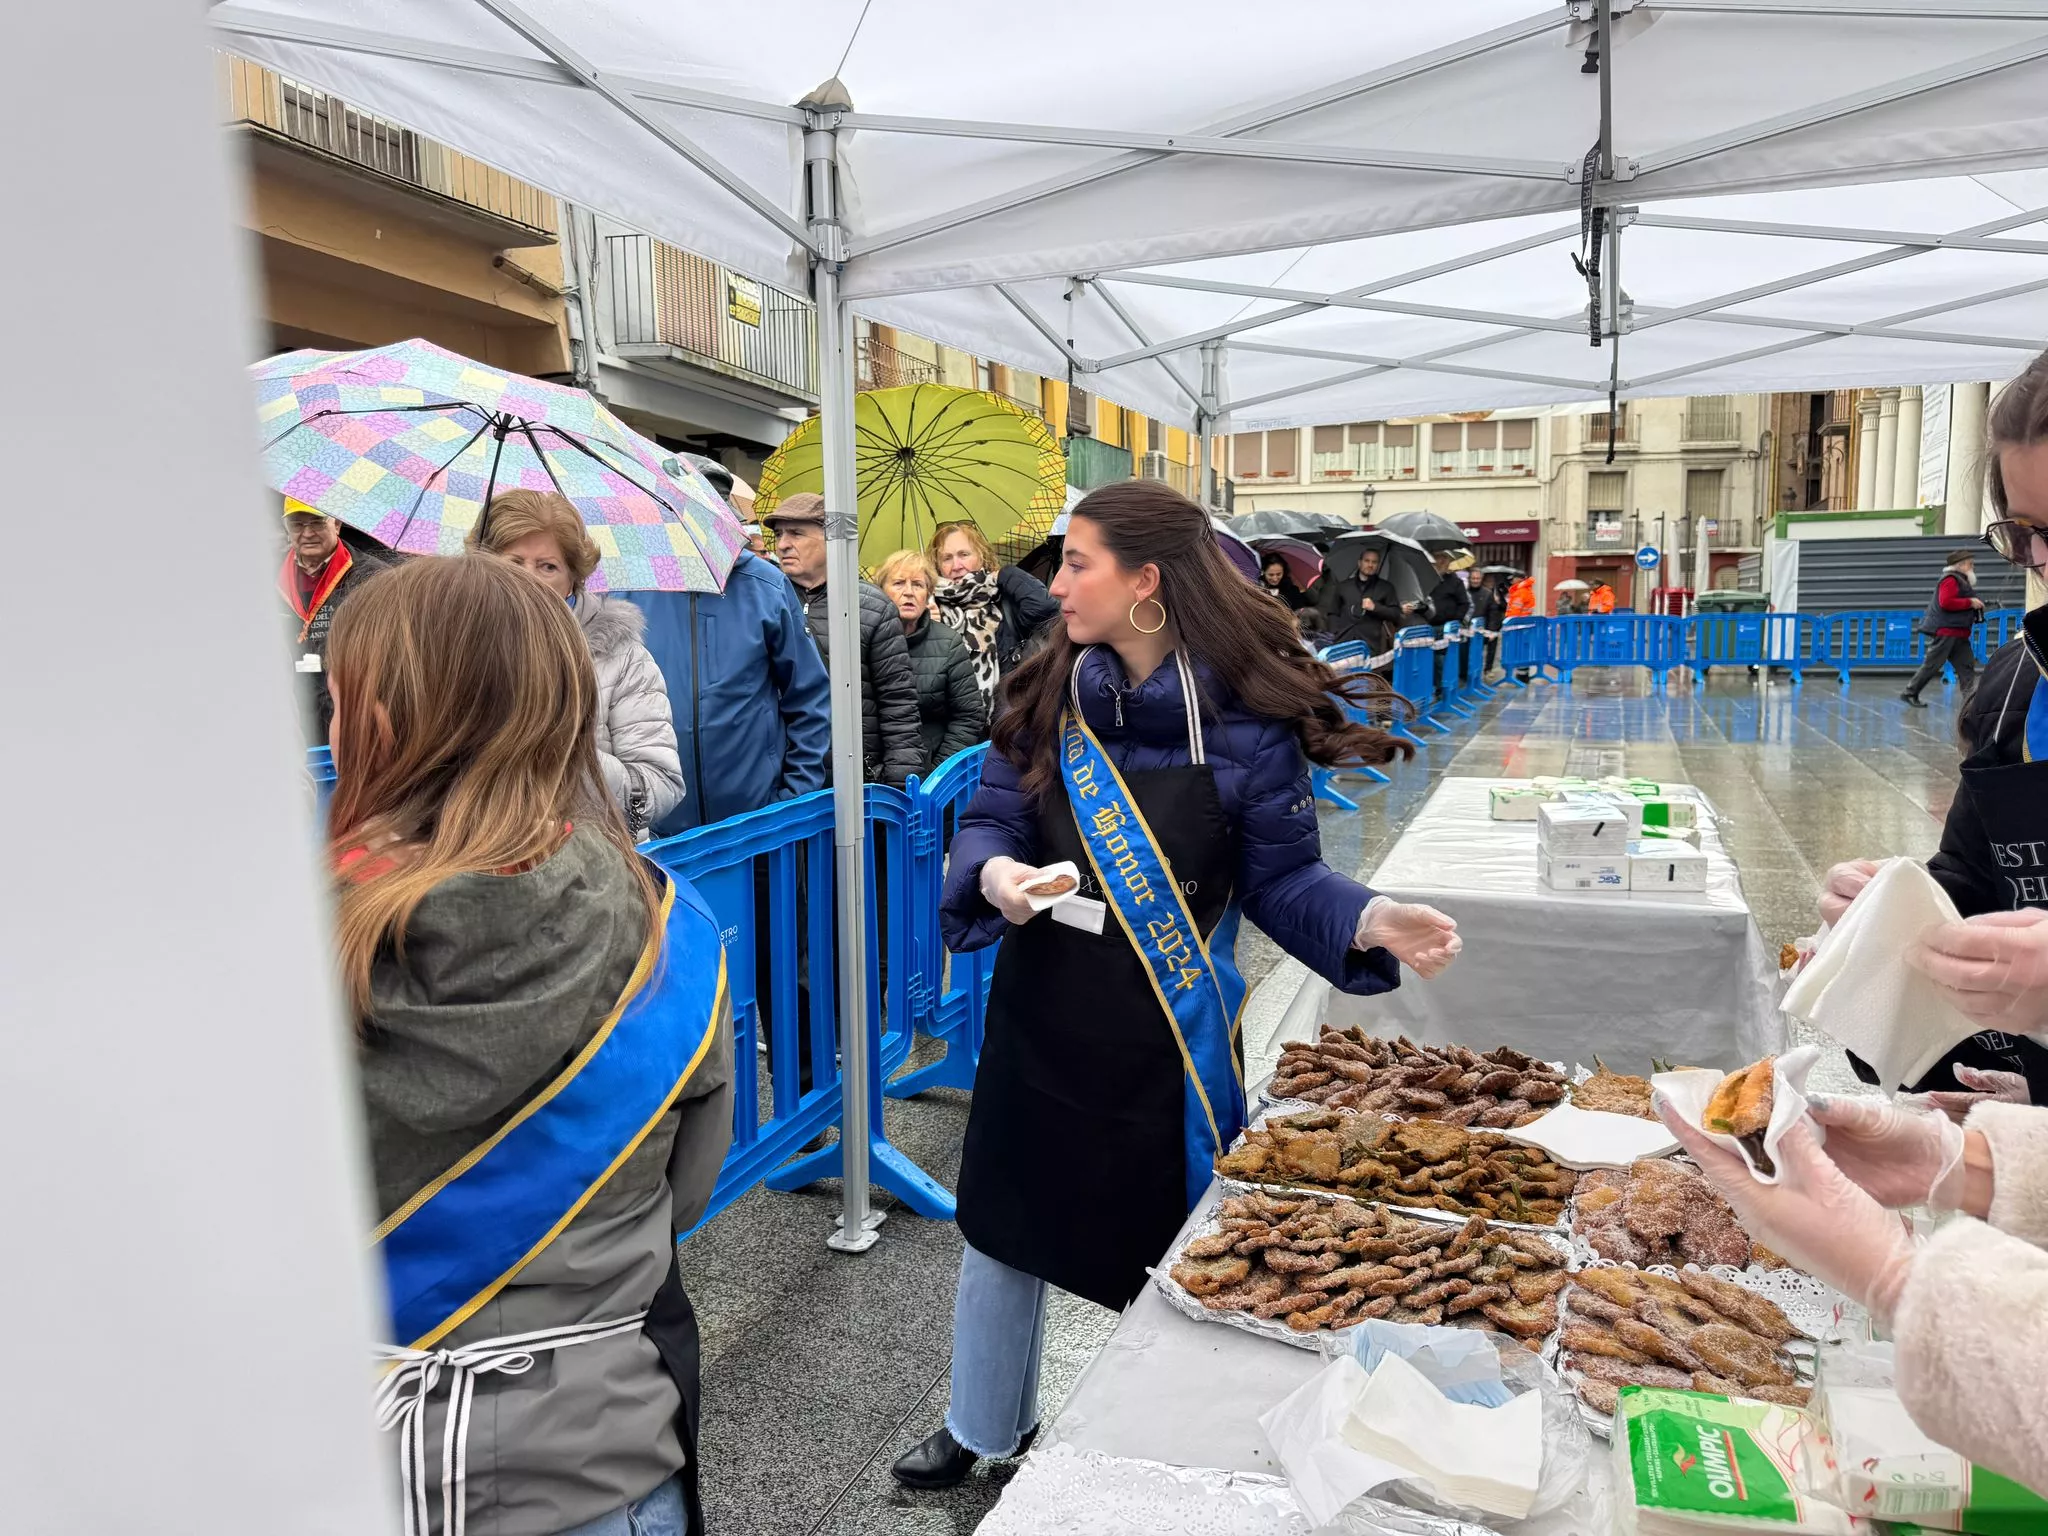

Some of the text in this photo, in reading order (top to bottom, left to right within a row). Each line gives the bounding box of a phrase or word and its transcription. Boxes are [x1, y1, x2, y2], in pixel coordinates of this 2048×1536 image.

[1072, 759, 1100, 800] de
[1091, 800, 1155, 906] Honor
[1147, 912, 1202, 990] 2024
[1696, 1424, 1735, 1498] OLIMPIC
